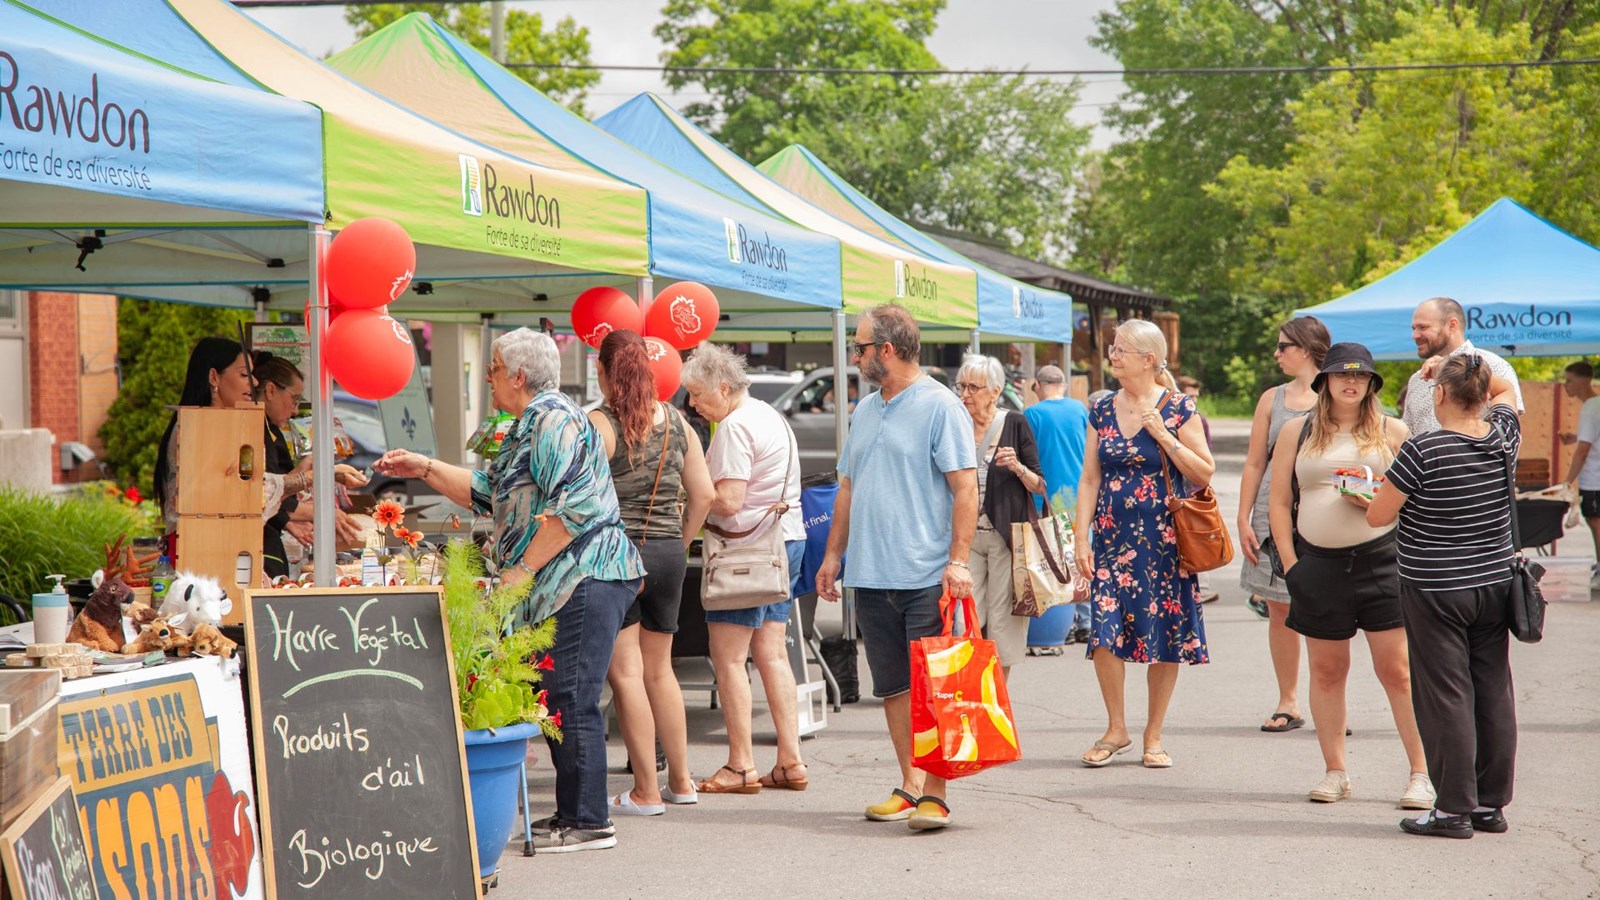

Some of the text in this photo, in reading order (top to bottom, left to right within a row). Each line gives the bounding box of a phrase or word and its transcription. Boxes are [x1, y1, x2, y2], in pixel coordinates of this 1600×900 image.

[0, 51, 150, 154] Rawdon
[43, 148, 63, 178] de
[66, 159, 83, 181] sa
[86, 156, 152, 191] diversité
[484, 163, 561, 229] Rawdon
[486, 225, 562, 257] Forte de sa diversité
[738, 223, 788, 272] Rawdon
[904, 263, 938, 301] Rawdon
[1466, 304, 1572, 330] Rawdon
[1497, 330, 1511, 341] de
[1513, 333, 1524, 341] sa
[1526, 328, 1573, 340] diversité
[810, 511, 831, 527] final.
[266, 598, 429, 671] Havre Végétal
[954, 690, 964, 702] C
[61, 690, 193, 785] TERRE DES
[273, 712, 370, 759] Produits
[361, 754, 425, 791] d'ail
[288, 829, 440, 889] Biologique
